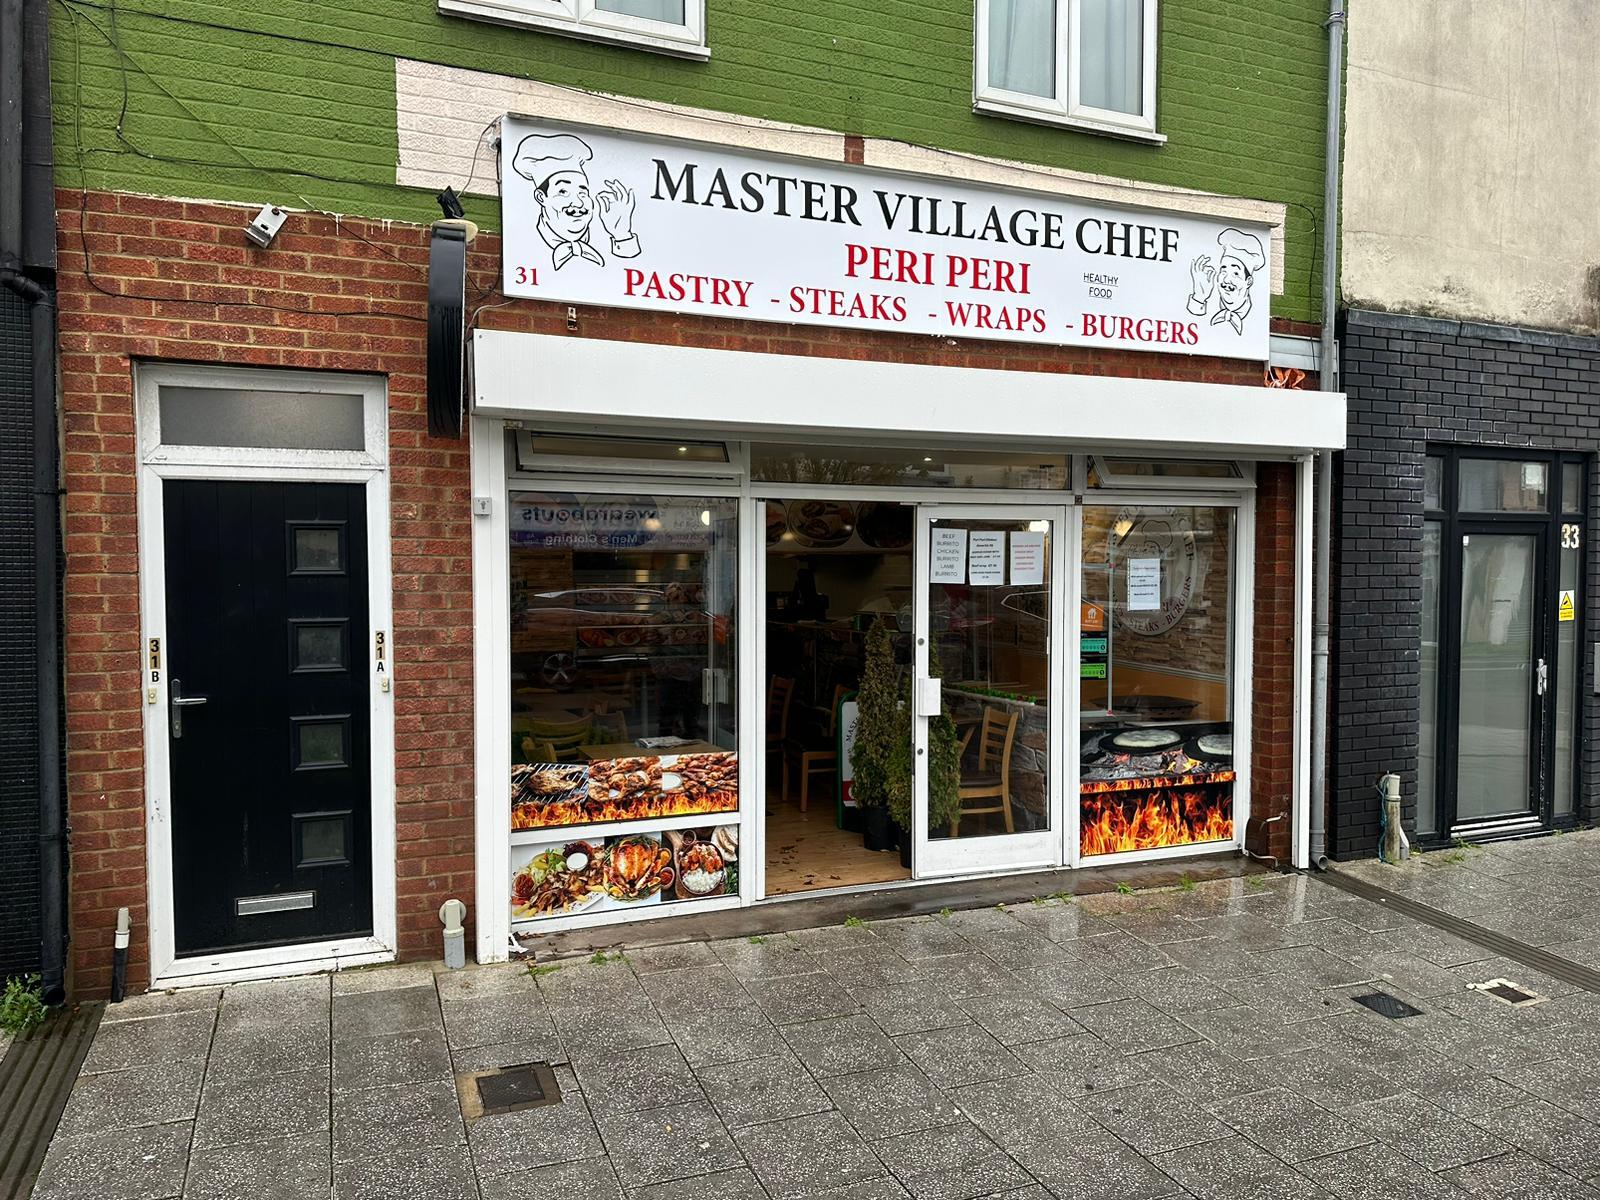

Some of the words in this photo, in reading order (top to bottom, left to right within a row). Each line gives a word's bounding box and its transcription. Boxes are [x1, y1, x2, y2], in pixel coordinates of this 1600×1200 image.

[651, 158, 862, 227] MASTER
[873, 190, 1065, 250] VILLAGE
[1075, 218, 1179, 263] CHEF
[515, 266, 539, 286] 31
[847, 243, 934, 286] PERI
[947, 256, 1030, 295] PERI
[1083, 272, 1119, 285] HEALTHY
[1088, 286, 1113, 299] FOOD
[624, 268, 754, 307] PASTRY
[789, 286, 907, 321] STEAKS
[946, 301, 1047, 332] WRAPS
[1081, 313, 1199, 345] BURGERS
[1561, 523, 1580, 549] 33
